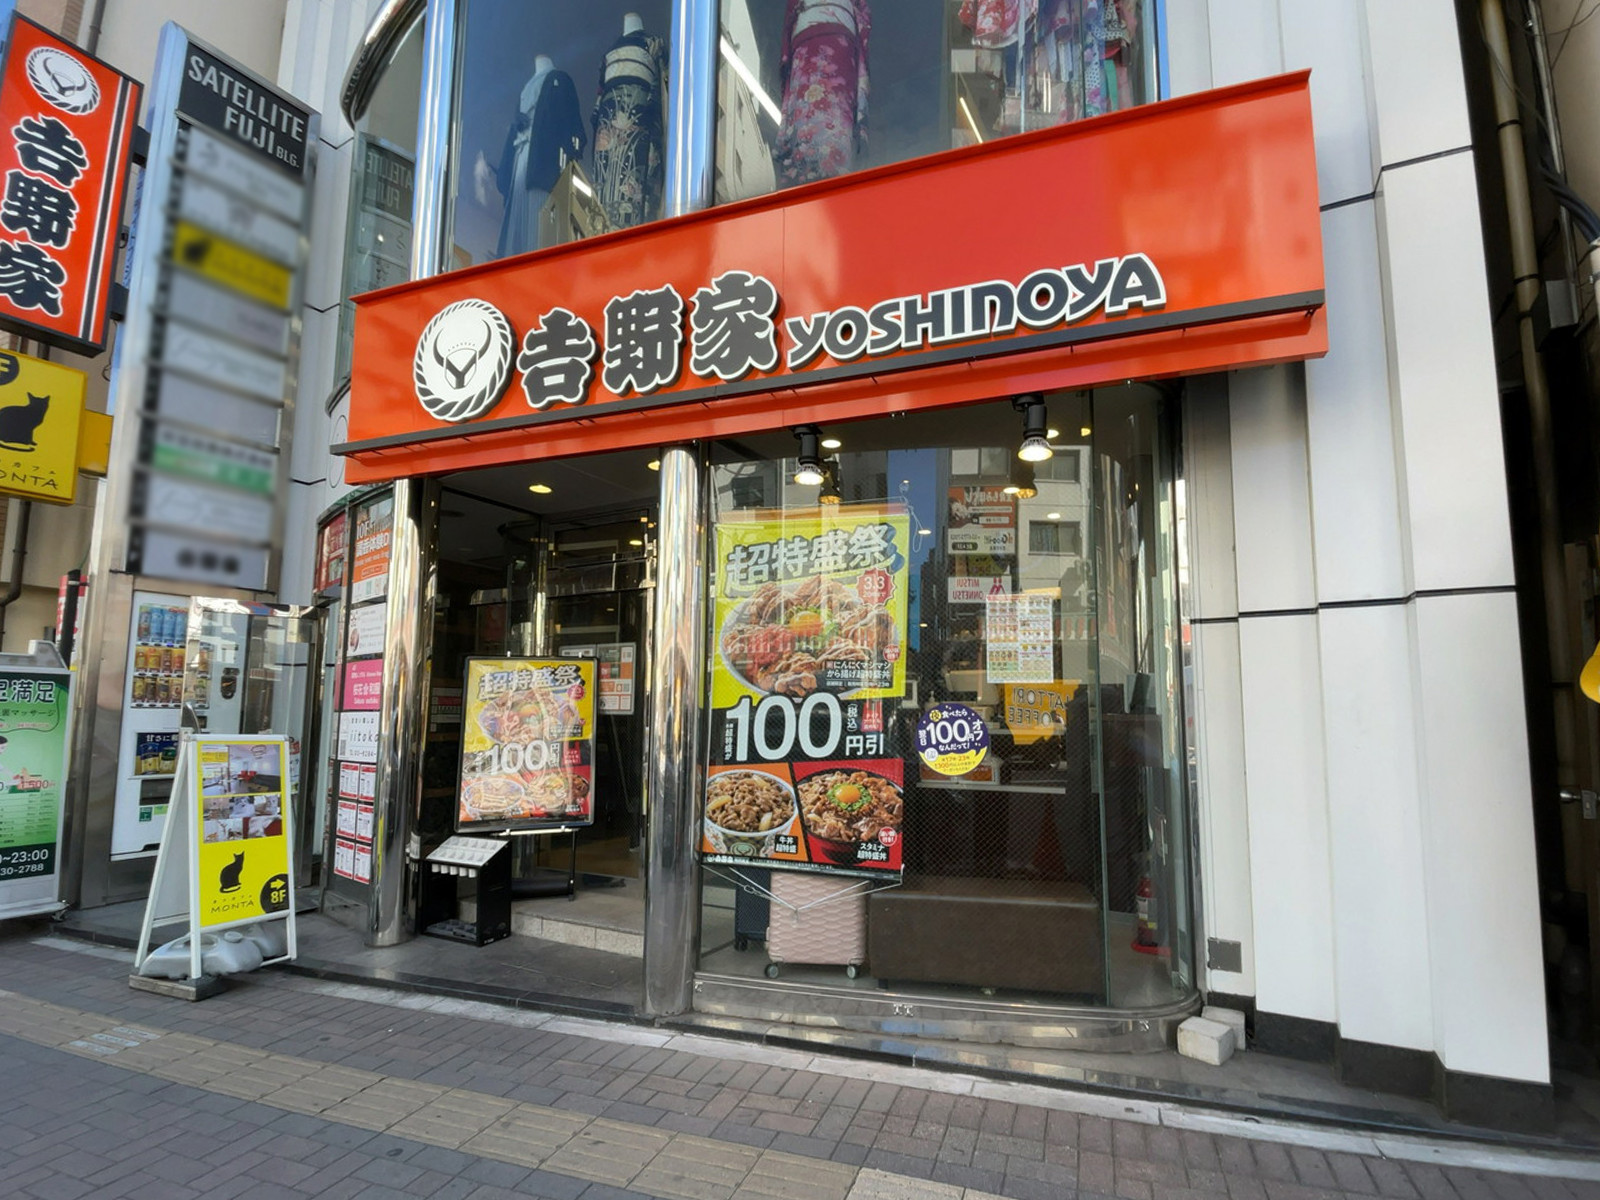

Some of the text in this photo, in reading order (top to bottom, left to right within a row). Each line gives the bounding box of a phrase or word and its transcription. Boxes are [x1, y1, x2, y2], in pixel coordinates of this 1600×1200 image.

[188, 55, 304, 143] SATELLITE
[224, 106, 275, 154] FUJI
[516, 270, 779, 410] 吉野家
[725, 524, 891, 596] 超特盛祭
[478, 664, 582, 701] 超特盛祭
[726, 692, 842, 761] 100
[845, 733, 884, 756] 円引
[488, 740, 548, 775] 100
[210, 889, 287, 913] MONTA 8F
